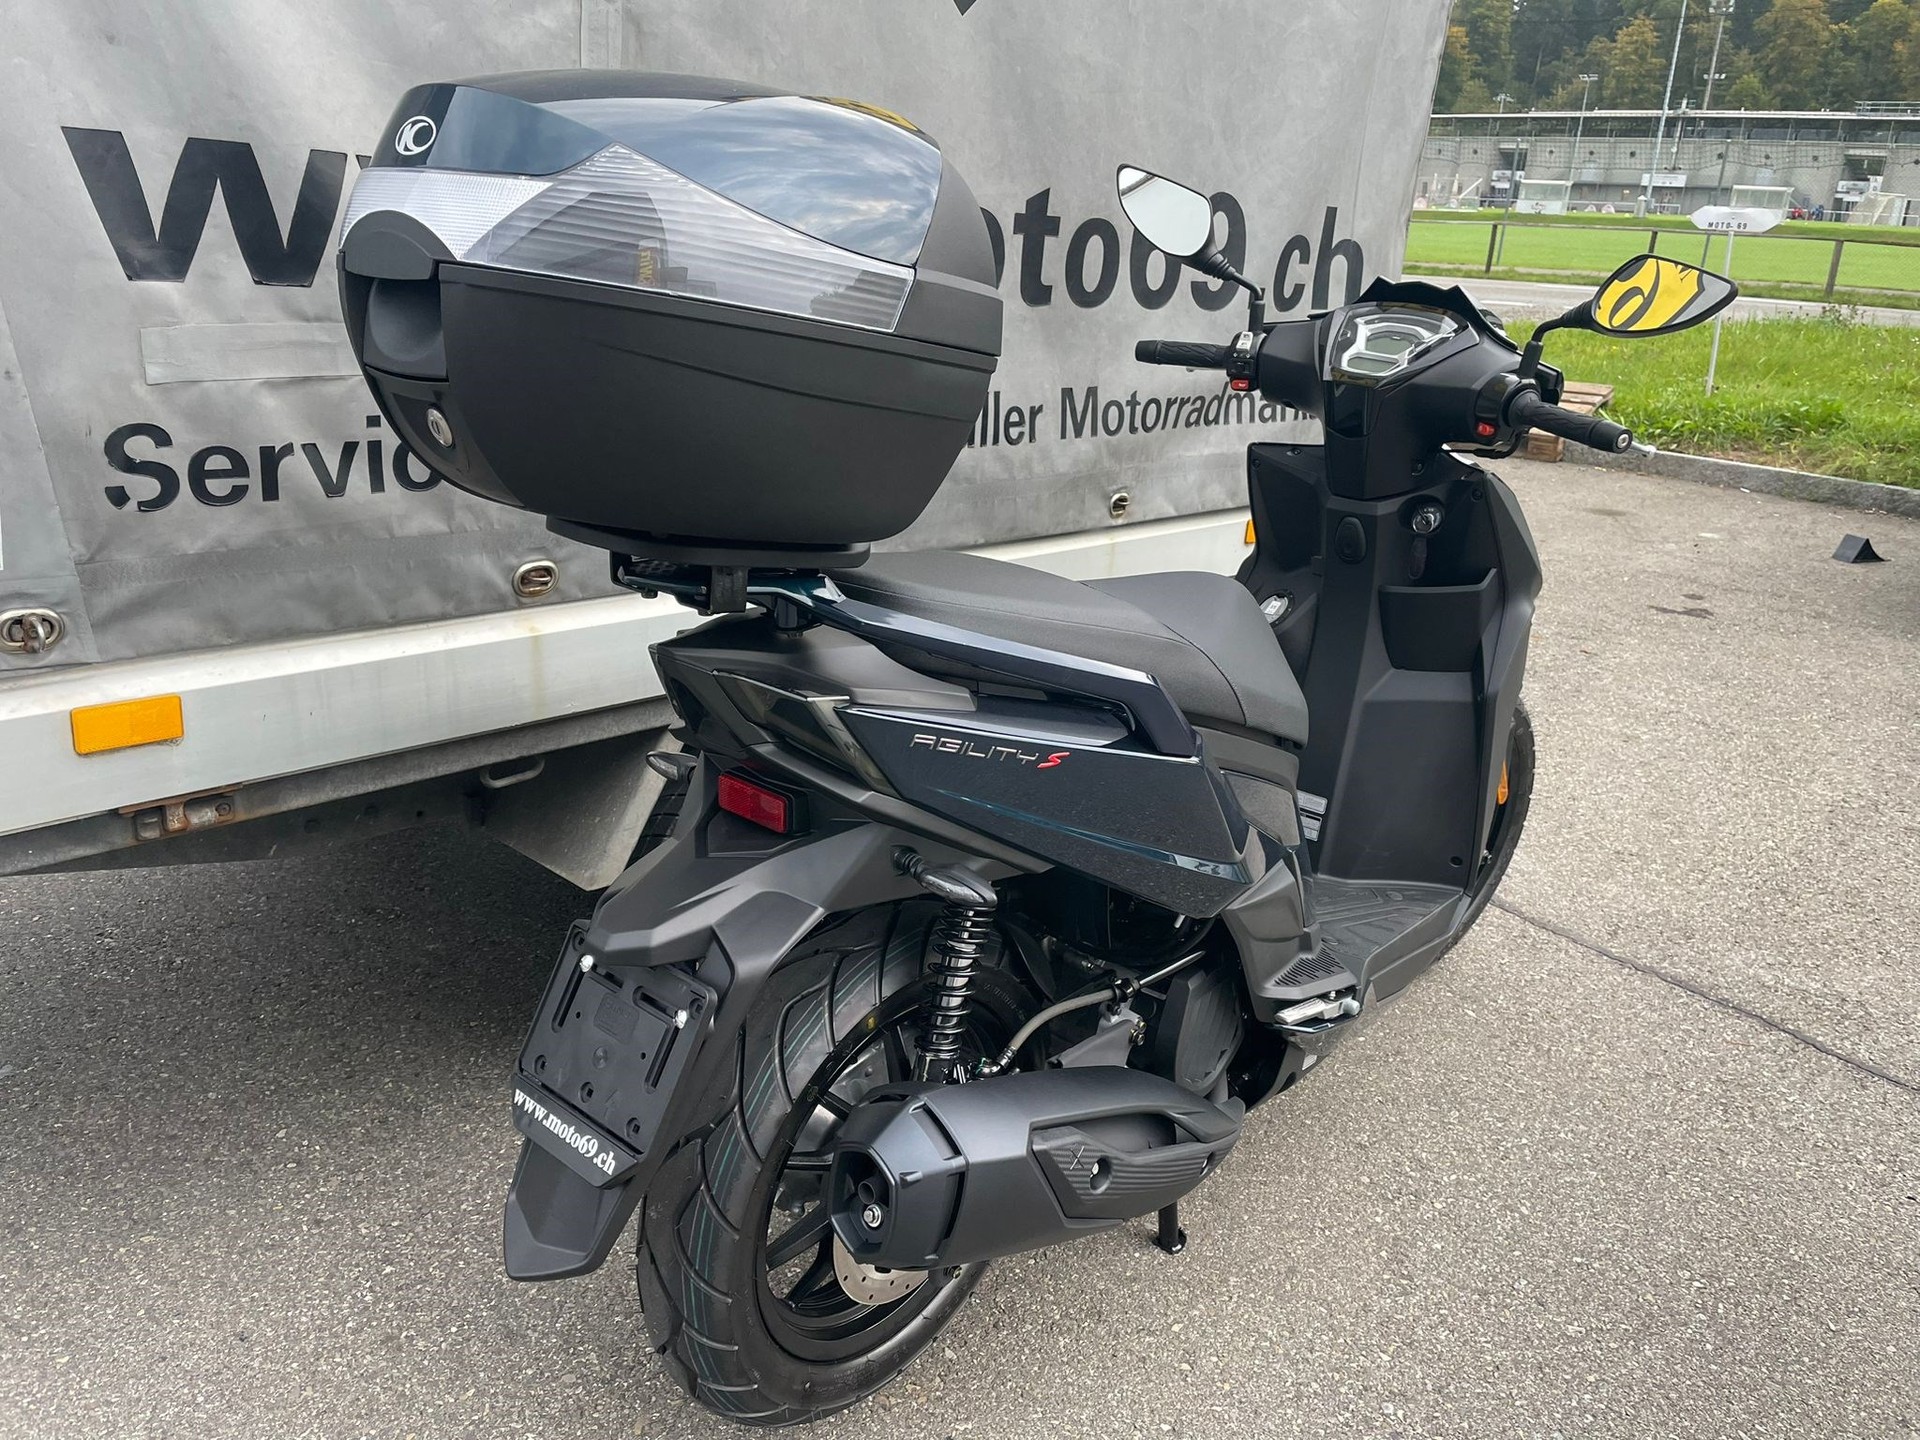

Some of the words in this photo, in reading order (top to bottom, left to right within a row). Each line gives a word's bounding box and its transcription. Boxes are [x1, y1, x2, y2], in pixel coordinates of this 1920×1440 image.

[909, 733, 1039, 765] AGILITY
[1036, 751, 1070, 769] S
[512, 1088, 616, 1176] www.moto69.ch
